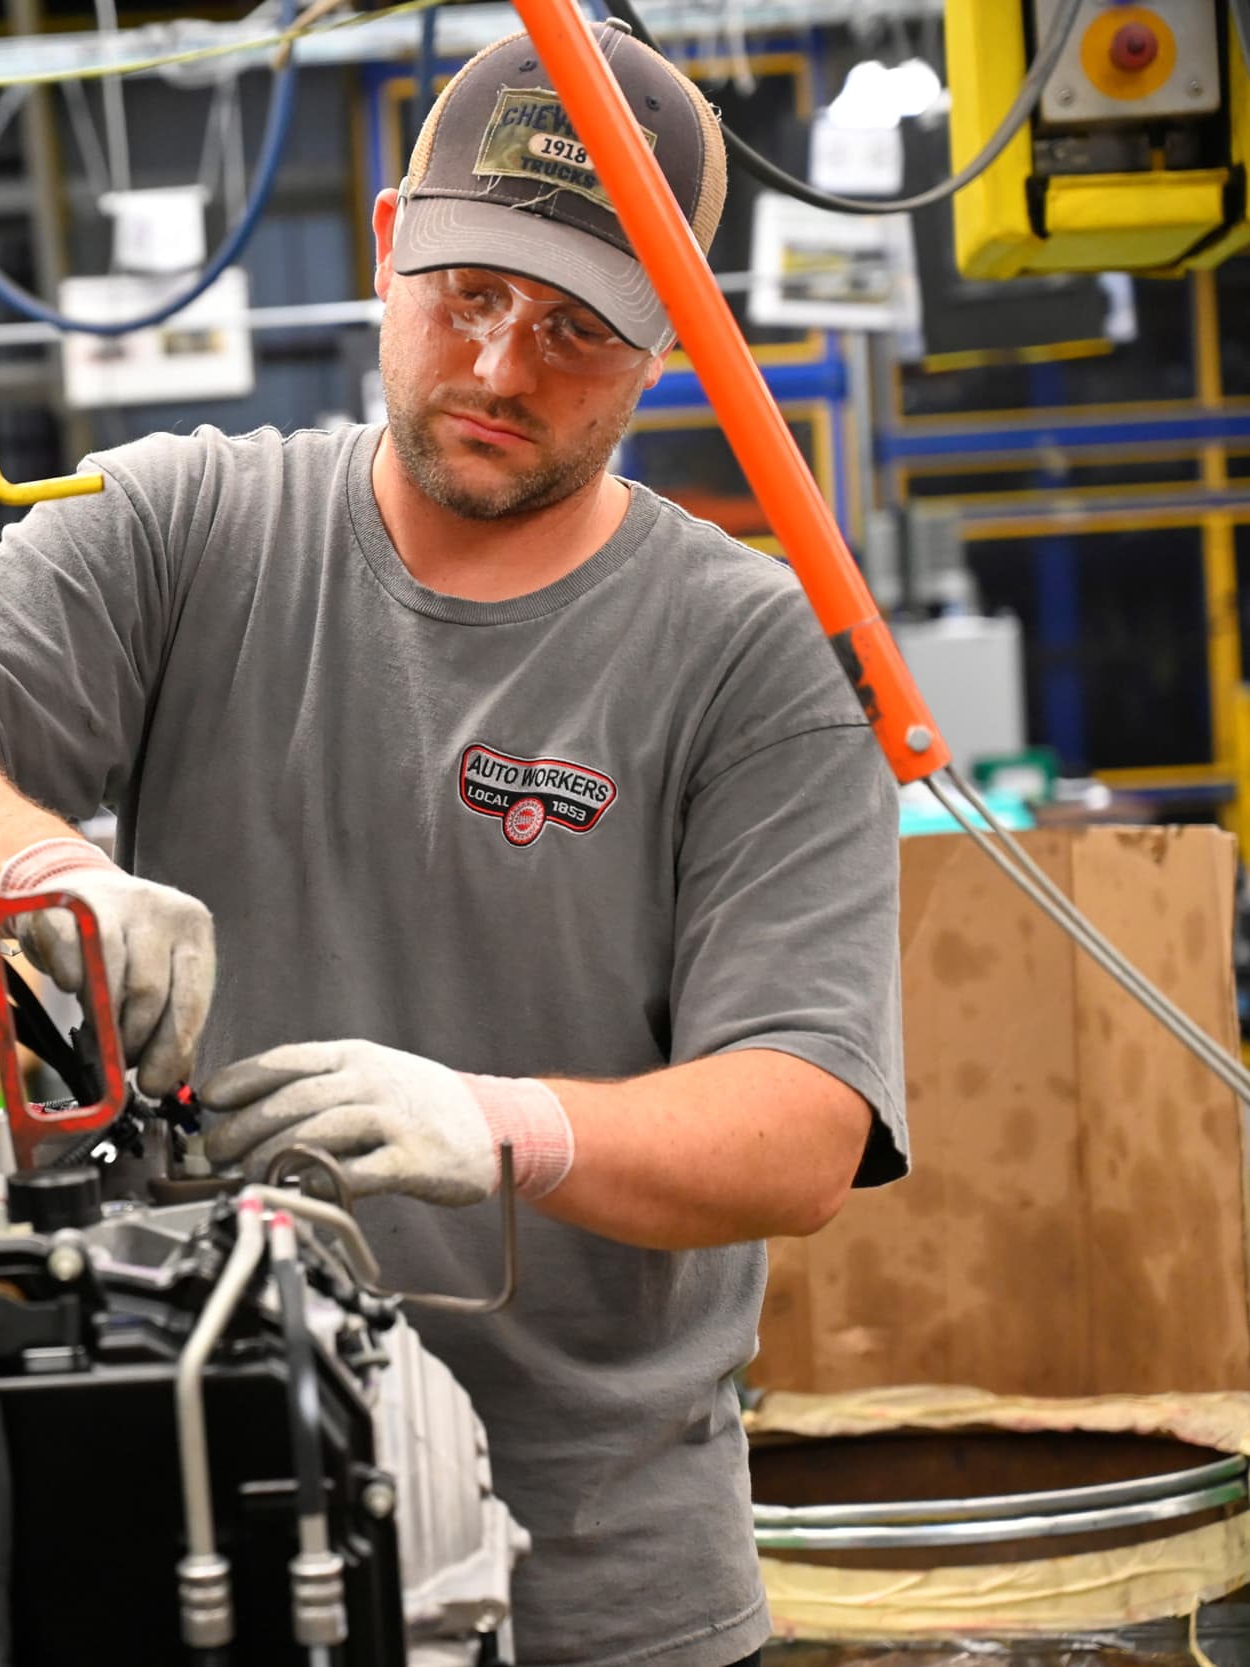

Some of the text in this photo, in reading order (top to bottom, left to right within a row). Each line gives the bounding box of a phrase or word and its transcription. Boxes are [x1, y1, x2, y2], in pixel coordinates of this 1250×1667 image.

[541, 138, 586, 163] 1918
[521, 156, 597, 188] TRUCKS
[468, 755, 608, 802] AUTO WORKERS
[468, 786, 509, 807] LOCAL
[552, 801, 587, 822] 1853
